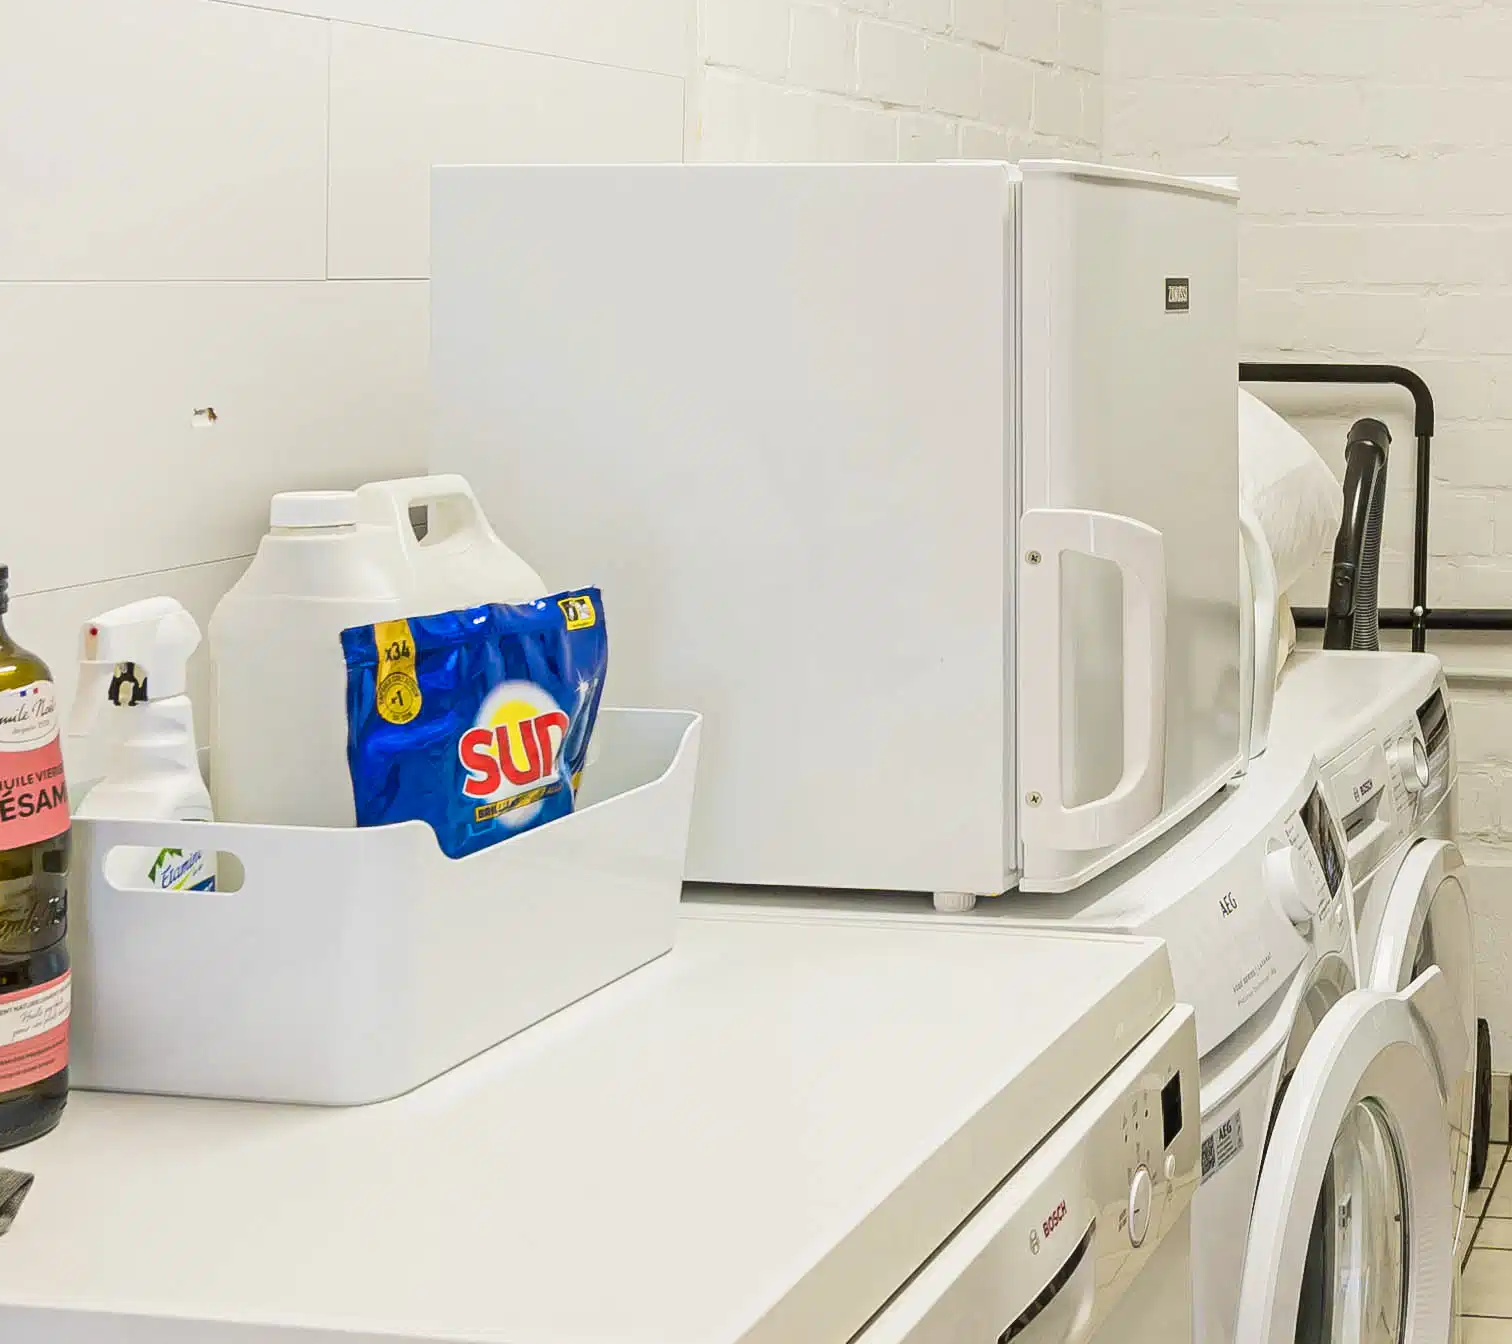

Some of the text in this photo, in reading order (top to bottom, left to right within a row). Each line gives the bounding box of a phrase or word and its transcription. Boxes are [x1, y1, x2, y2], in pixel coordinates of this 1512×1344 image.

[1218, 891, 1238, 918] AEG
[1218, 1119, 1232, 1141] AEG
[1042, 1199, 1067, 1238] BOSCH
